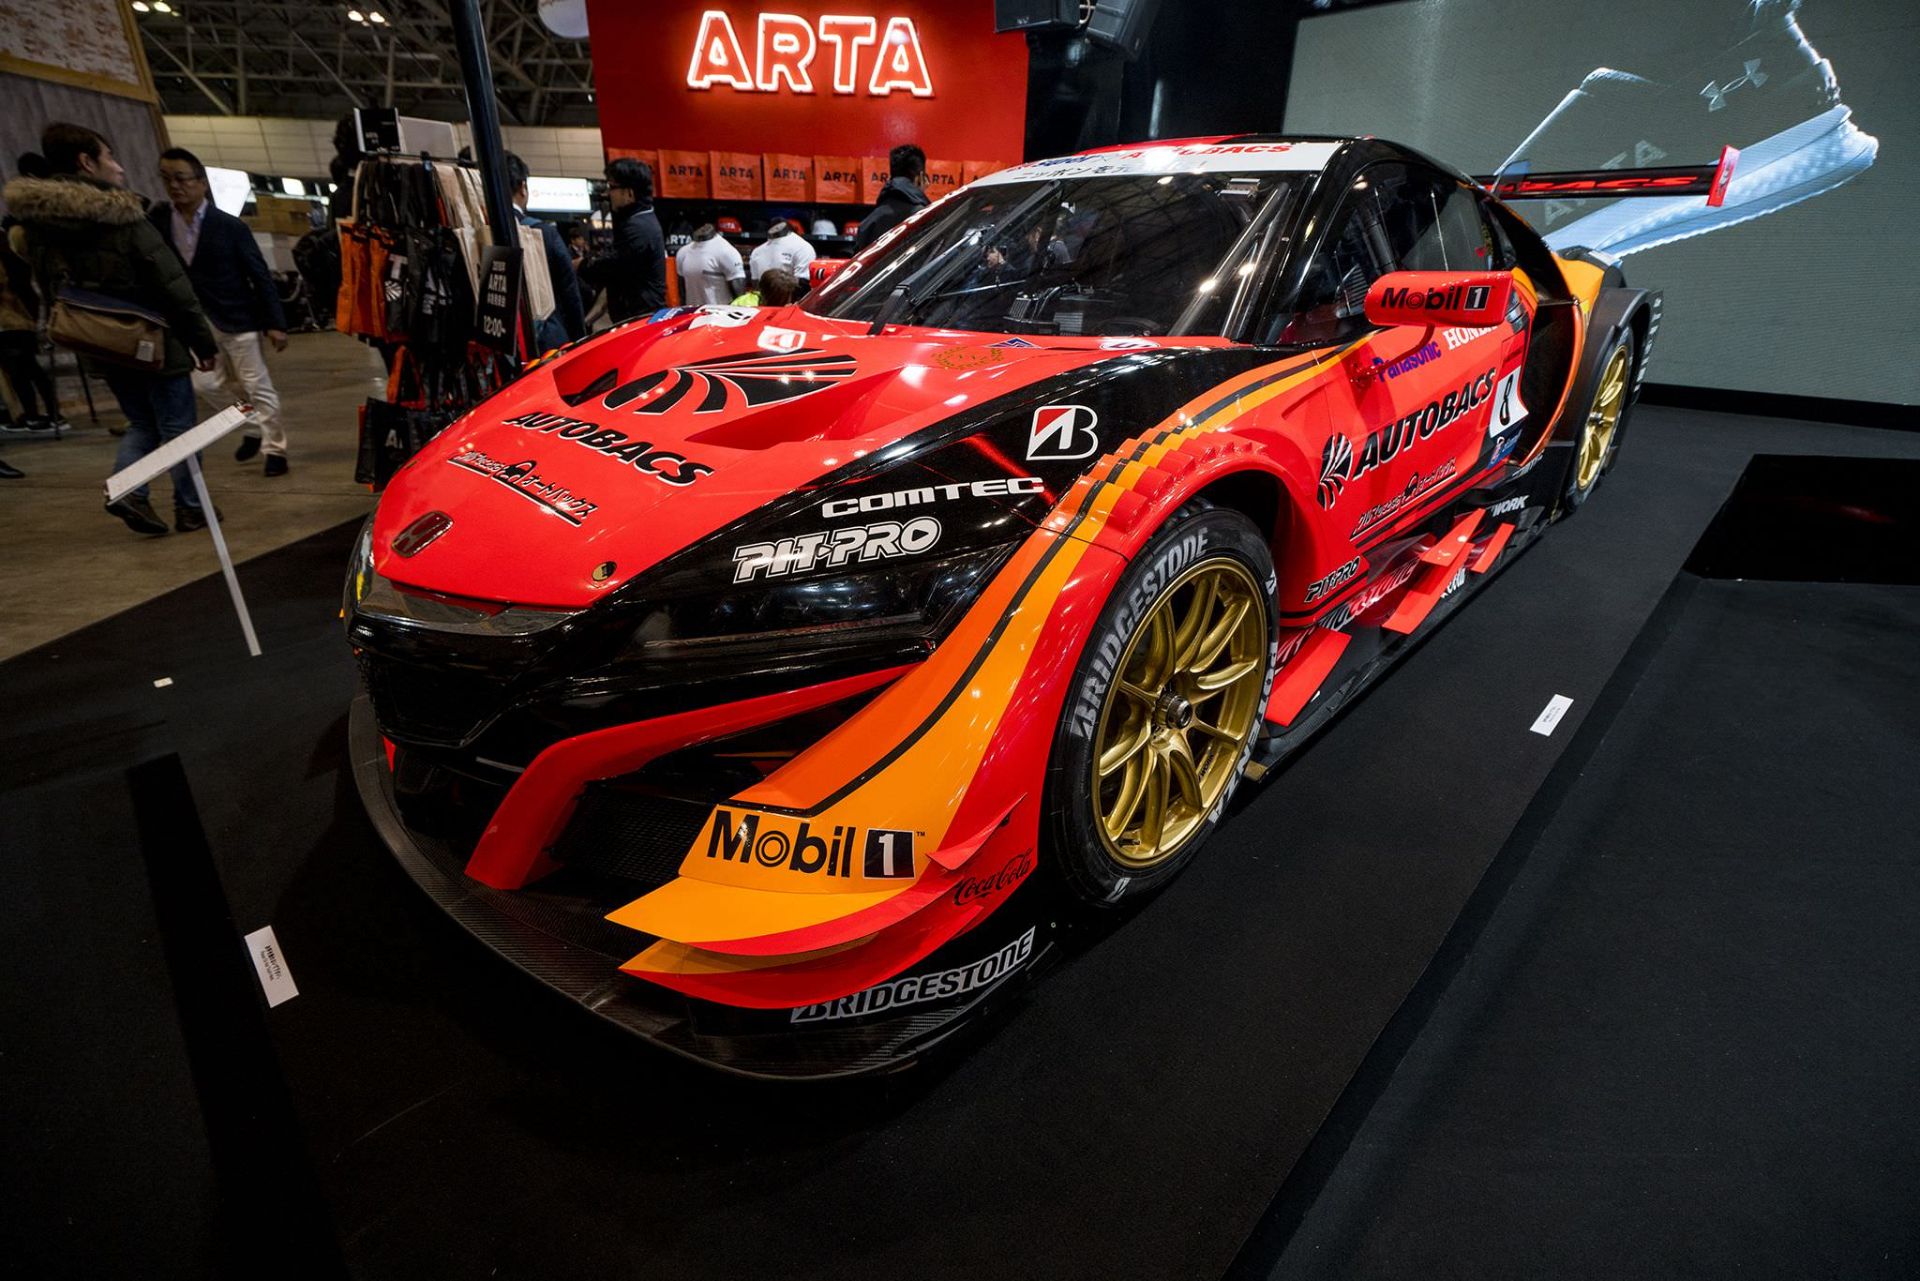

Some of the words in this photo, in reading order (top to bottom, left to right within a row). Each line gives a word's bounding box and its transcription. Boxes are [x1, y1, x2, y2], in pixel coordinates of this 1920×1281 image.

[686, 10, 933, 96] ARTA
[668, 164, 703, 177] ARTA
[719, 165, 754, 179] ARTA
[773, 168, 806, 180] ARTA
[823, 170, 858, 183] ARTA
[872, 172, 888, 182] AR
[1380, 287, 1462, 311] Mobil
[1352, 366, 1497, 481] AUTOBACS
[501, 411, 715, 487] AUTOBACS
[822, 476, 1045, 519] COMTEC
[1486, 494, 1530, 517] WORK
[1070, 527, 1209, 738] BRIDGESTONE
[706, 809, 856, 879] Mobil
[790, 925, 1036, 1024] BRIDGESTONE
